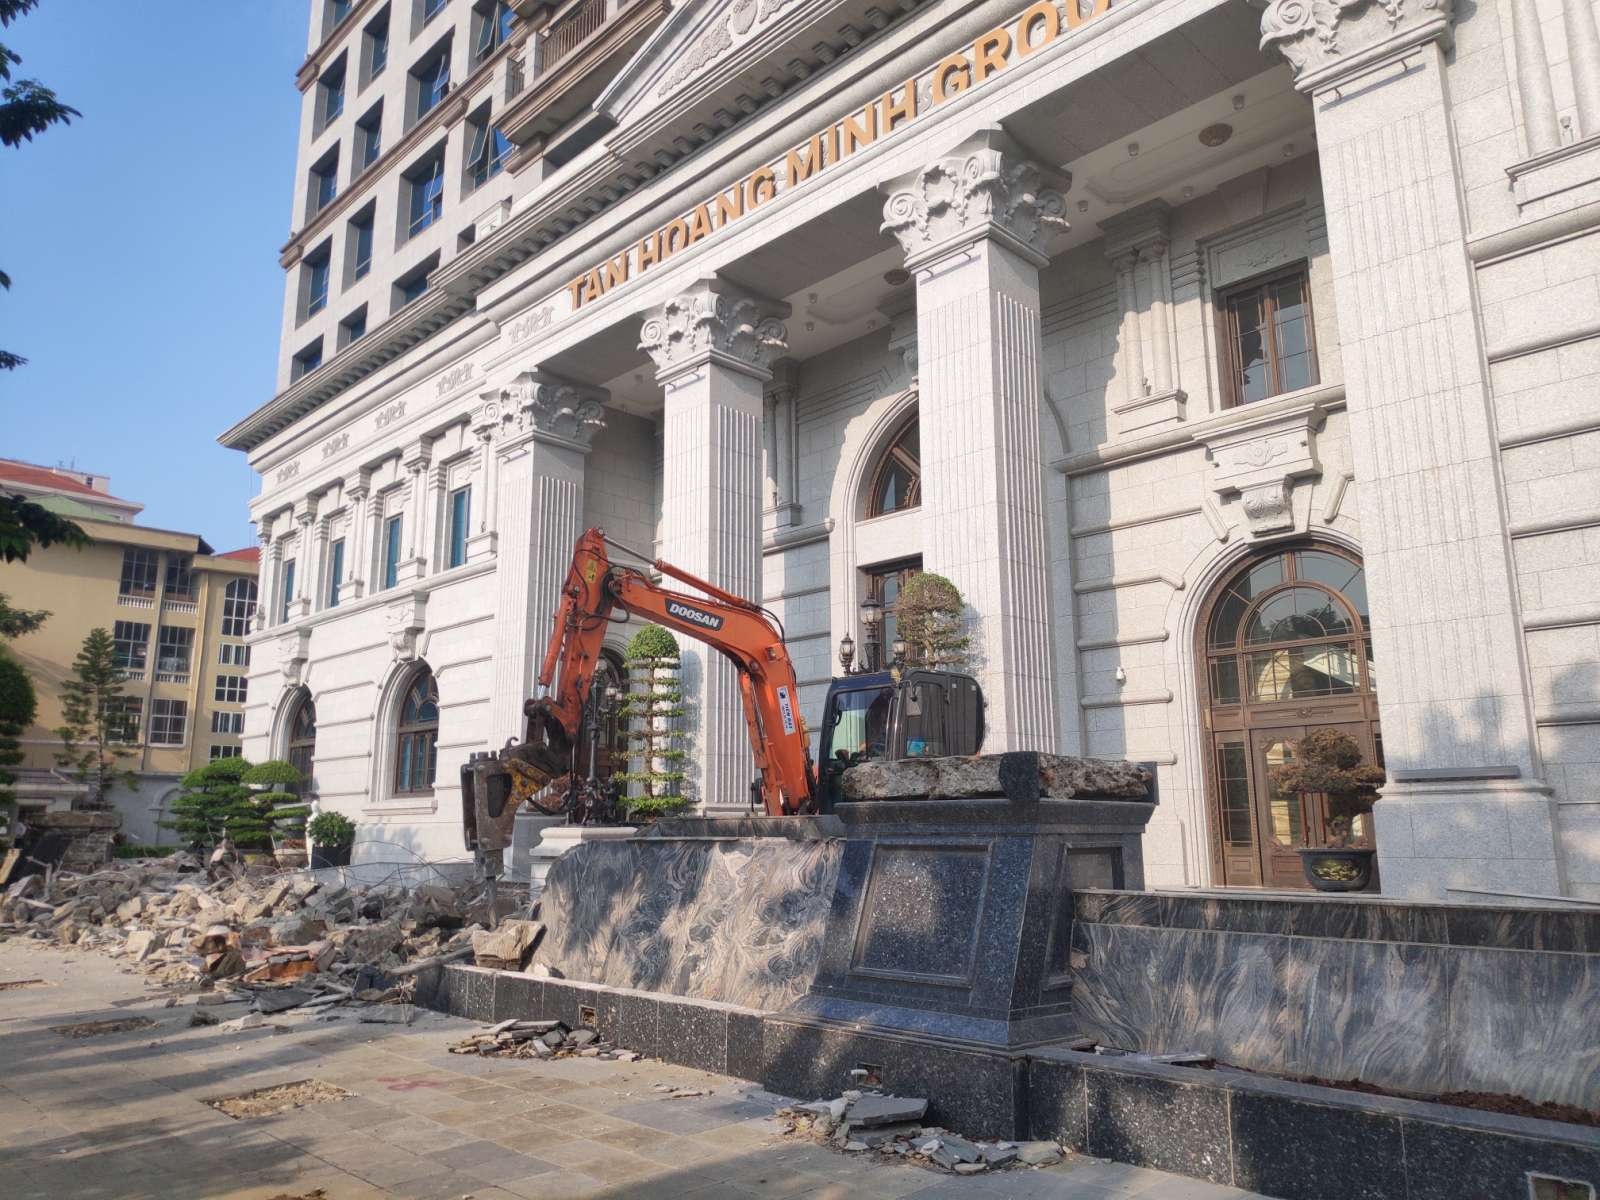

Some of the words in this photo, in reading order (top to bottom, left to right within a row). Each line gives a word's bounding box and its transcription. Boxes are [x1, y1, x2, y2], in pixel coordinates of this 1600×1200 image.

[567, 254, 629, 311] TAN
[637, 169, 777, 273] HOANG
[786, 80, 919, 186] MINH
[669, 603, 719, 627] DOOSAN
